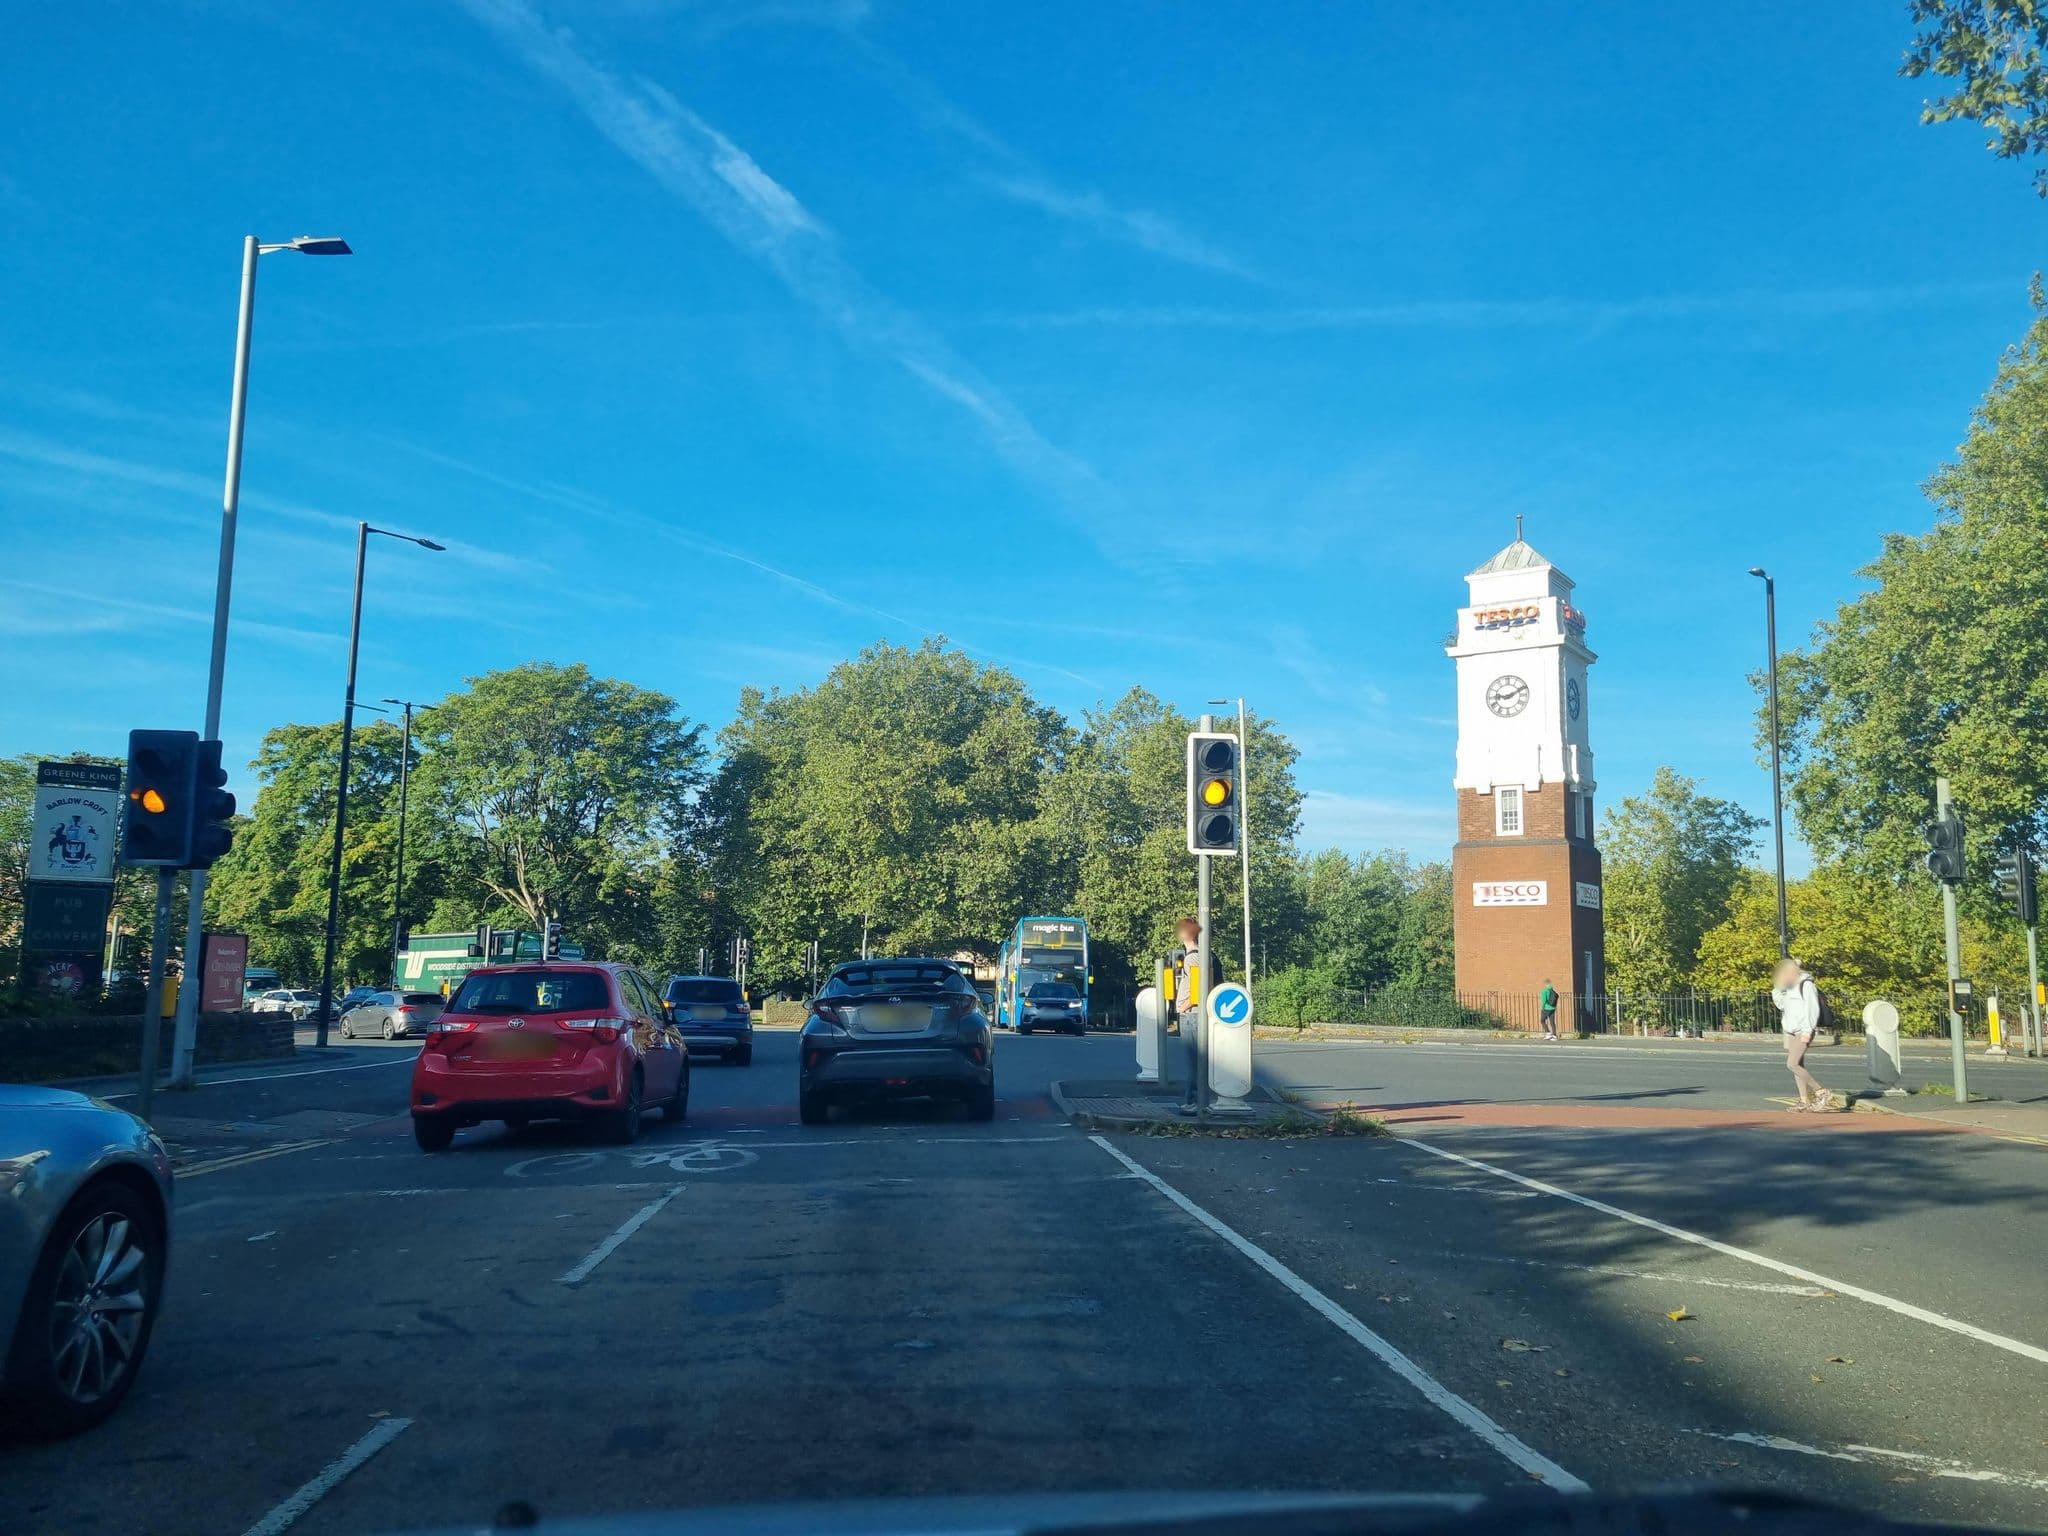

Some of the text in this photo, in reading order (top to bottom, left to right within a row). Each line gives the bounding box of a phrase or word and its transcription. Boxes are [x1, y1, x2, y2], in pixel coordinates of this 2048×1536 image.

[1474, 605, 1539, 624] TESCO
[43, 768, 86, 779] GREENE
[89, 773, 116, 781] KING
[46, 798, 108, 816] BARLOW CROFT
[1480, 885, 1541, 898] TESCO
[1032, 924, 1074, 933] magic bus
